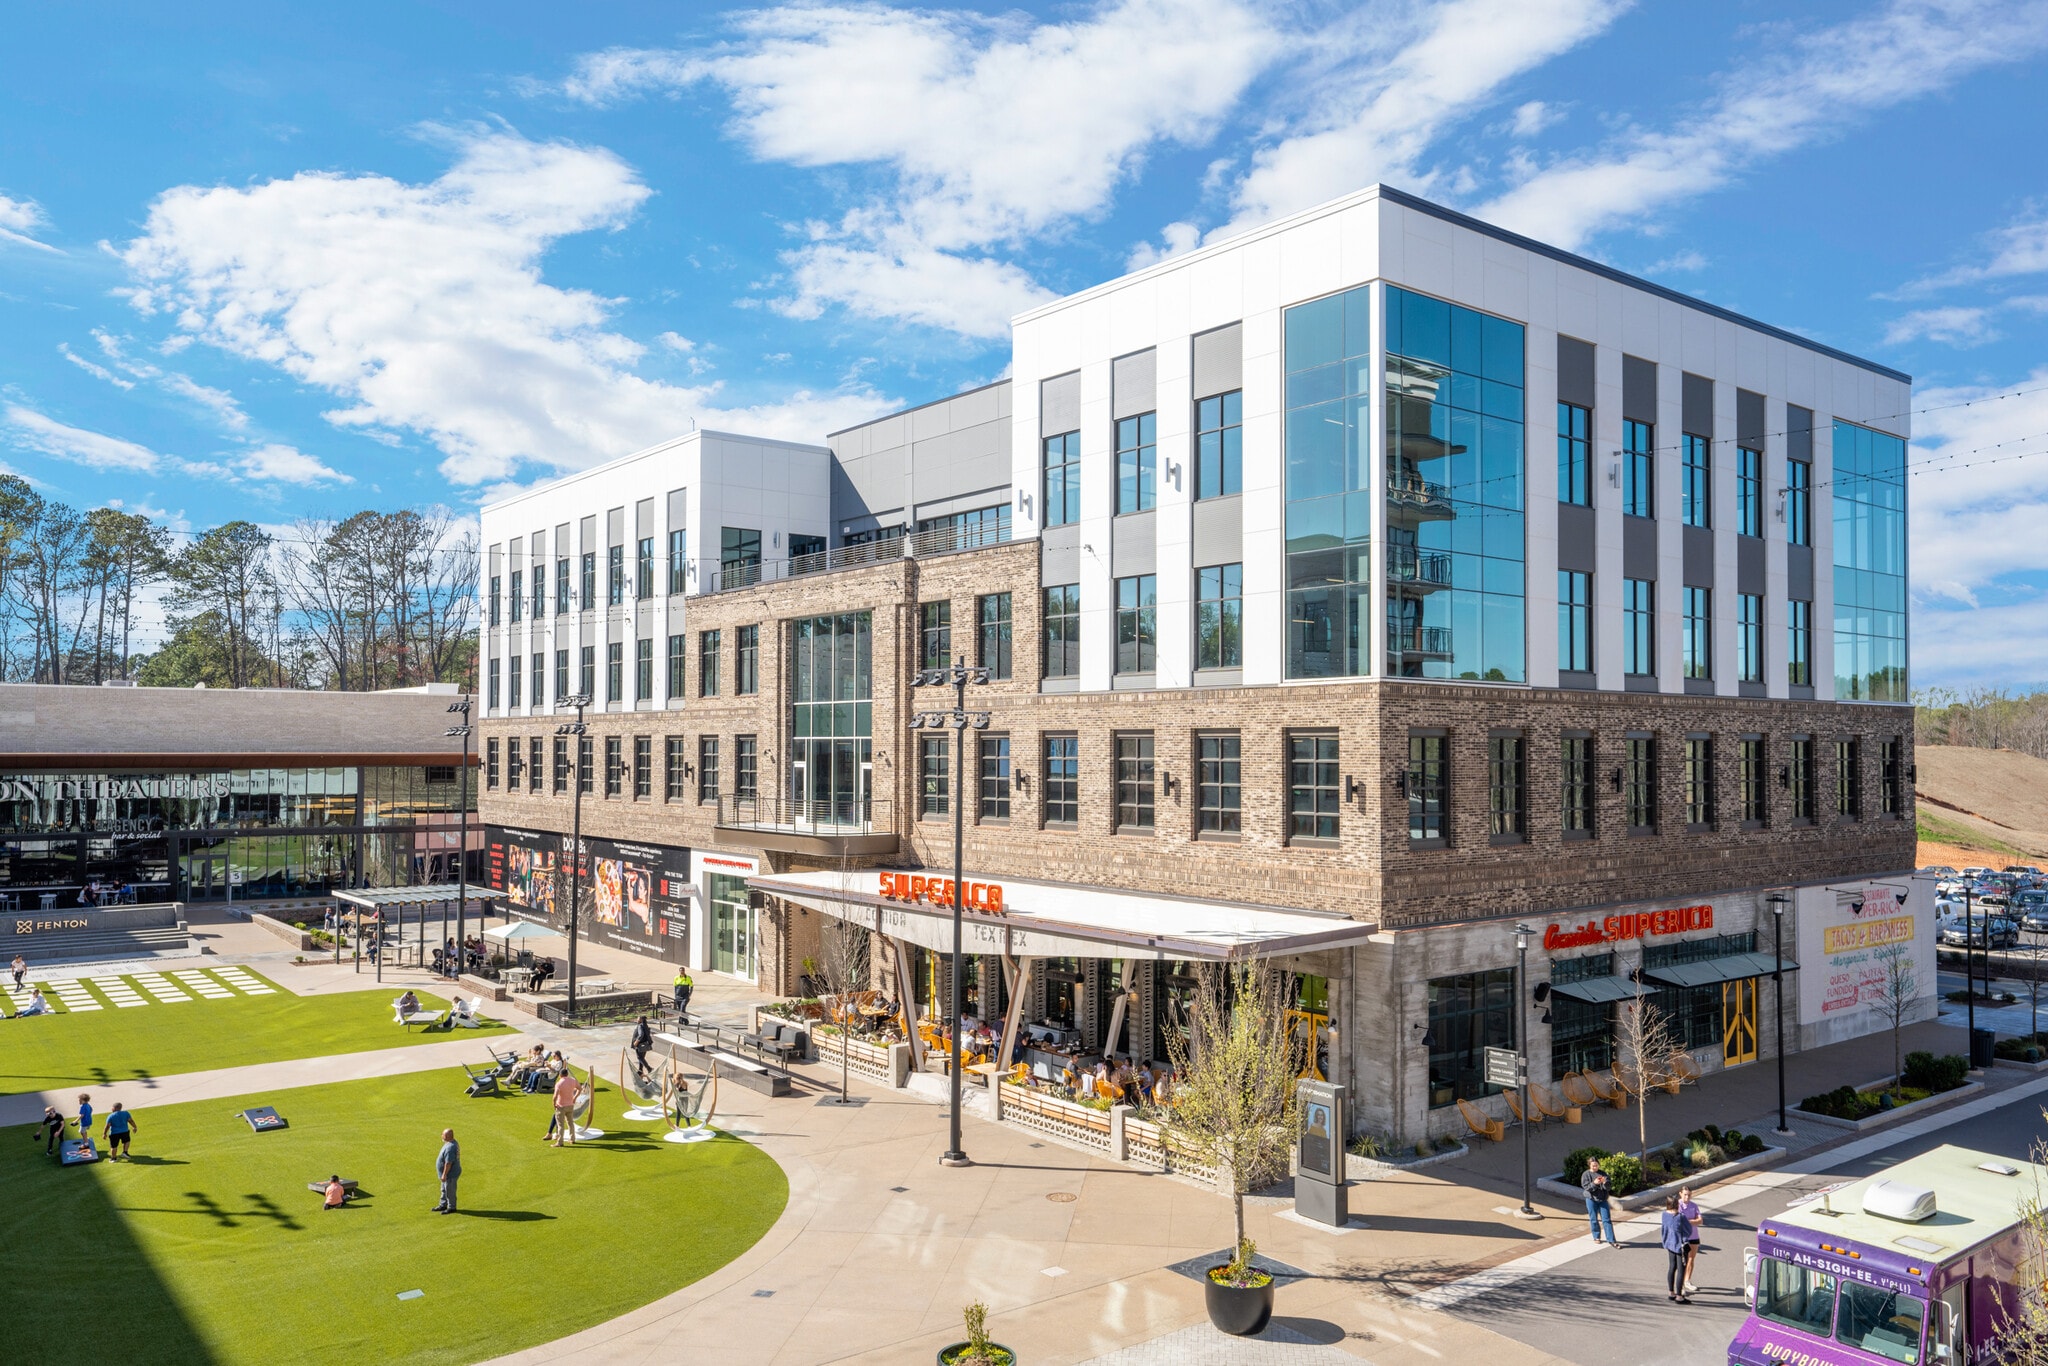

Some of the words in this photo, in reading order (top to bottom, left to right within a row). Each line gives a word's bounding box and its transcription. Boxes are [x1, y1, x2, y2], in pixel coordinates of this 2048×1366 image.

[49, 778, 230, 800] THEATERS
[136, 830, 162, 839] social
[879, 871, 1003, 913] SUPERICA
[36, 918, 88, 930] FENTON
[973, 924, 996, 943] TEX
[1604, 905, 1713, 943] SUPERICA
[1831, 927, 1856, 948] TACOS
[1829, 972, 1850, 986] QUESO
